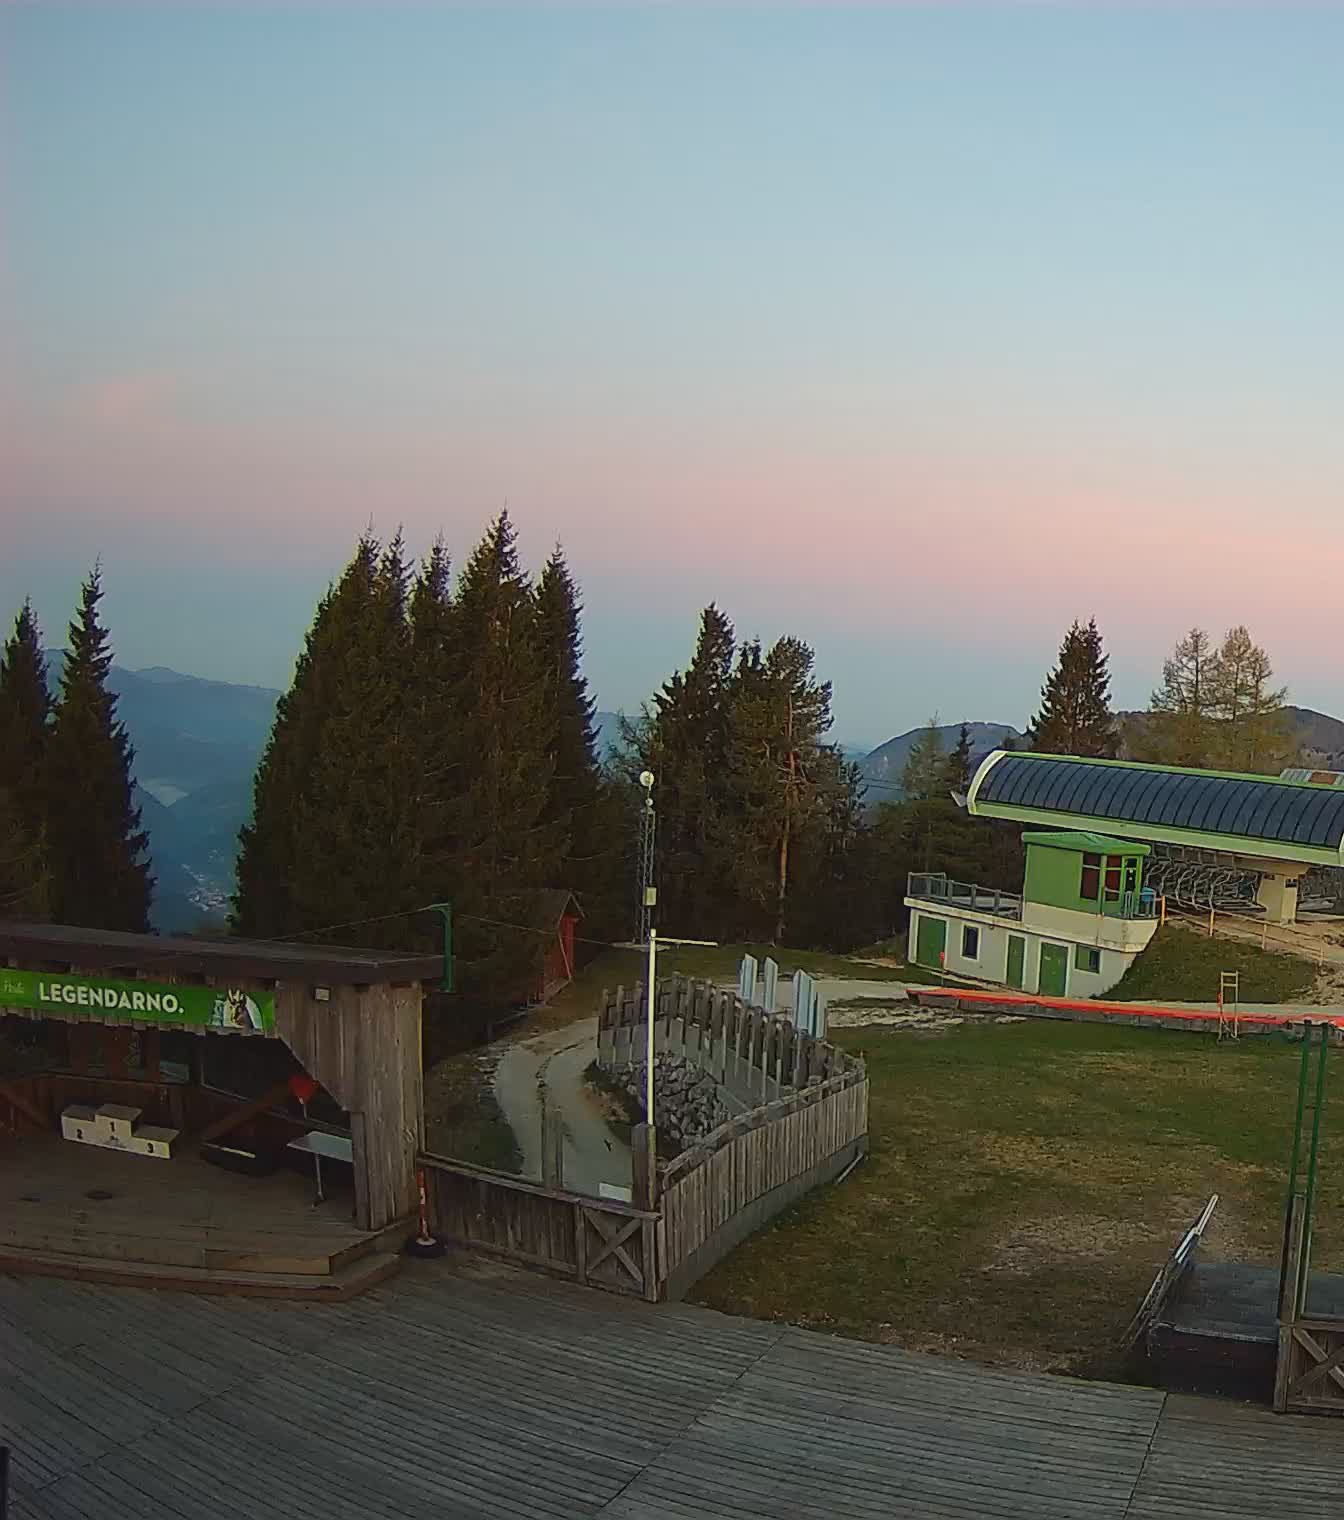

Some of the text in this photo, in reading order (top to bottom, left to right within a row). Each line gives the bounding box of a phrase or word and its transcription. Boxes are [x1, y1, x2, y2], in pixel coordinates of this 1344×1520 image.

[39, 982, 184, 1014] LEGENDARNO.
[76, 1128, 83, 1140] 2
[147, 1142, 154, 1154] 3
